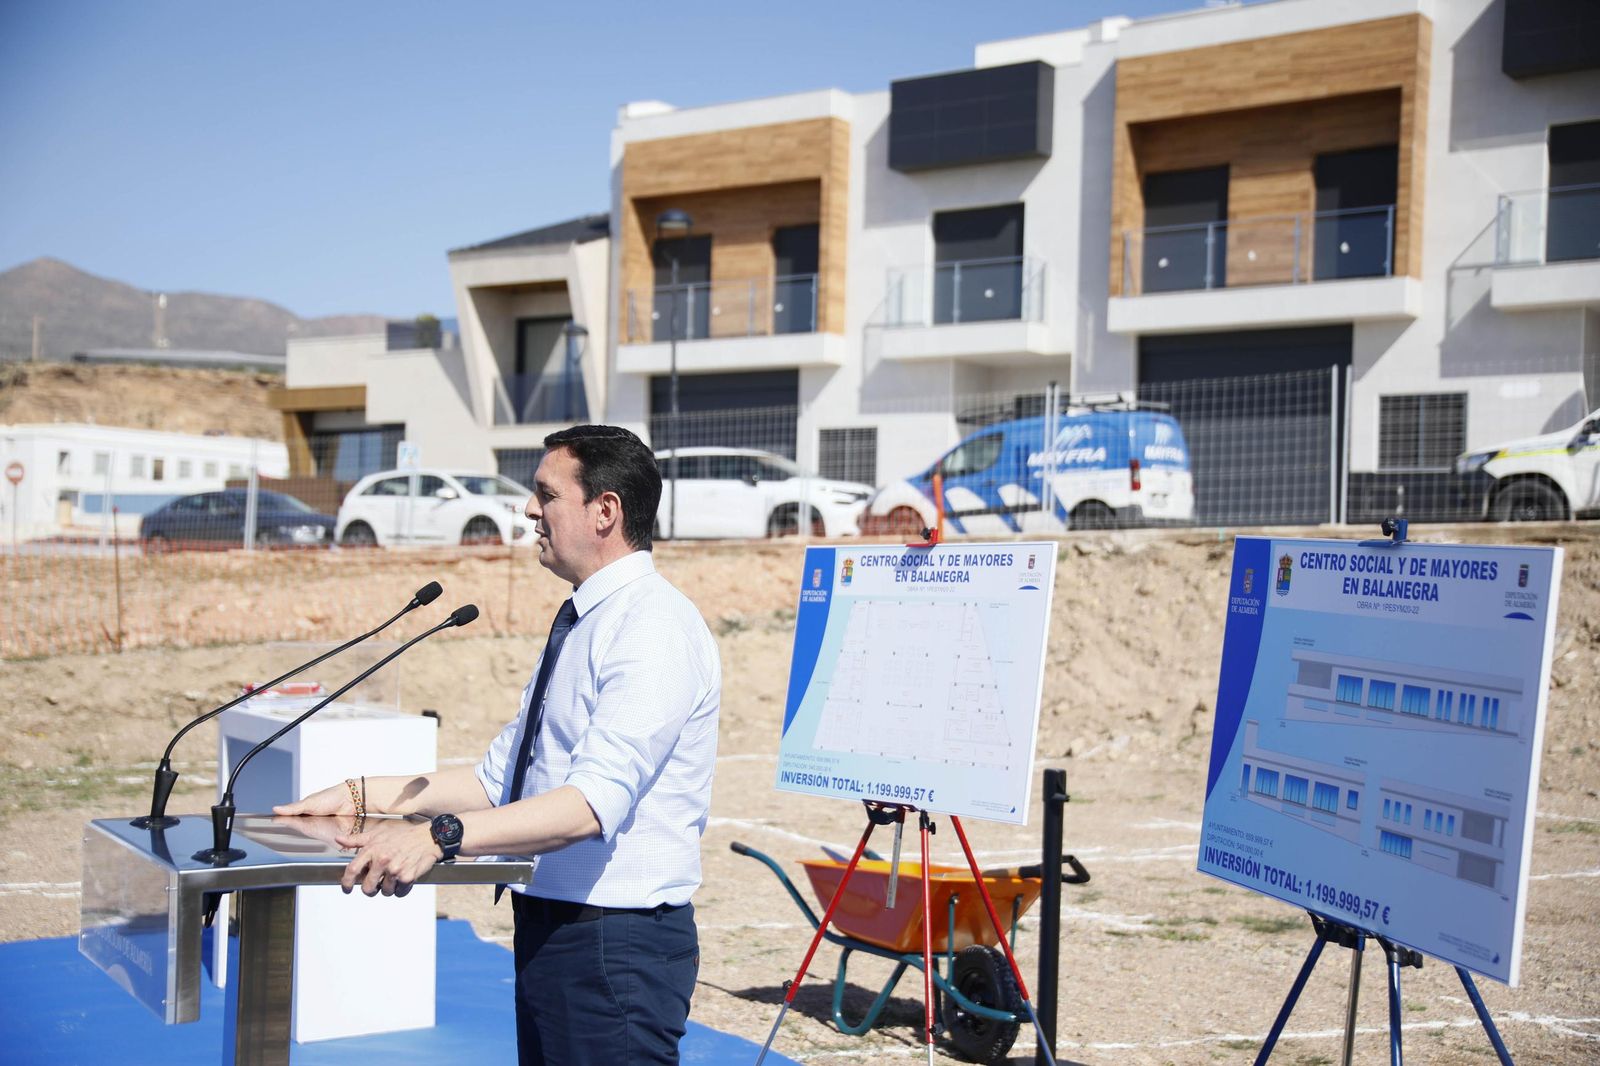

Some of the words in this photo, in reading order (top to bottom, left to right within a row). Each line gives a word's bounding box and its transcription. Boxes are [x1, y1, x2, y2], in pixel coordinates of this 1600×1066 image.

[860, 555, 897, 567] CENTRO
[900, 554, 936, 567] SOCIAL
[938, 554, 946, 566] Y
[948, 554, 961, 566] DE
[963, 553, 1013, 566] MAYORES
[1300, 552, 1347, 572] CENTRO
[1350, 555, 1394, 574] SOCIAL
[1397, 558, 1407, 575] Y
[1409, 559, 1427, 577] DE
[1430, 559, 1498, 581] MAYORES
[895, 570, 909, 583] EN
[910, 570, 970, 583] BALANEGRA
[1342, 577, 1360, 595] EN
[1362, 579, 1439, 602] BALANEGRA
[1356, 600, 1373, 609] OBRA
[781, 770, 829, 788] INVERSIÓN
[831, 777, 864, 793] TOTAL:
[867, 781, 926, 802] 1.199.999,57
[928, 789, 935, 802] €
[1204, 845, 1260, 880] INVERSIÓN
[1263, 863, 1303, 895] TOTAL:
[1305, 879, 1379, 921] 1.199.999,57
[1381, 906, 1391, 926] €
